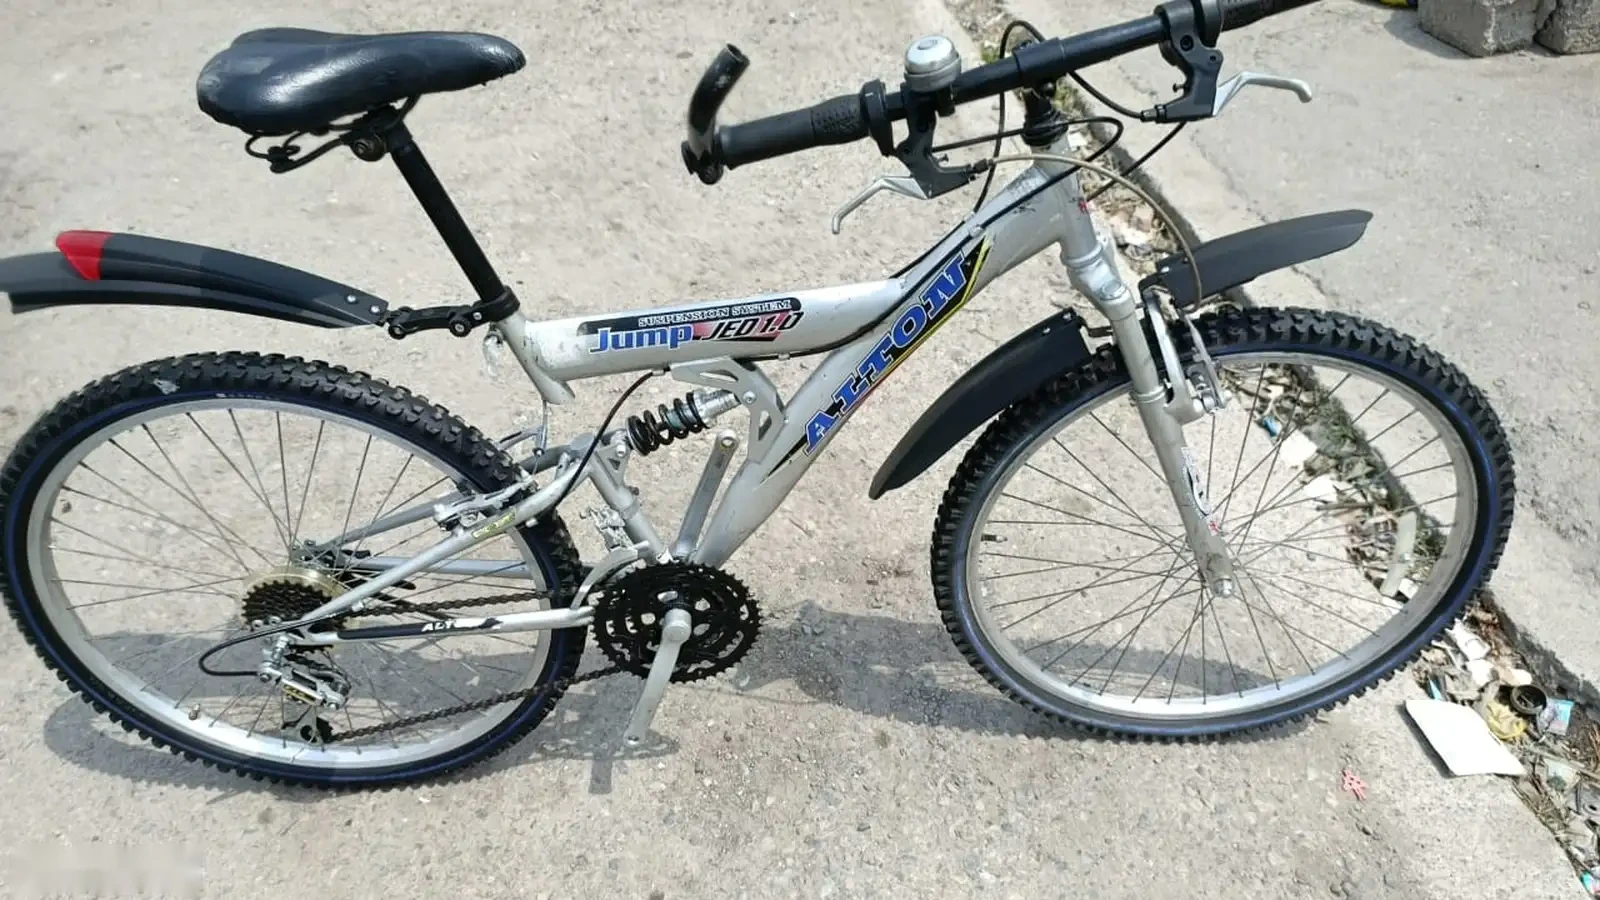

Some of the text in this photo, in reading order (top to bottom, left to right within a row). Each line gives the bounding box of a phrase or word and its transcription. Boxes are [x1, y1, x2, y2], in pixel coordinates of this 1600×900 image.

[637, 300, 792, 327] SUSPENSION SYSTEM
[590, 326, 695, 353] Jump
[804, 251, 967, 455] ALTON
